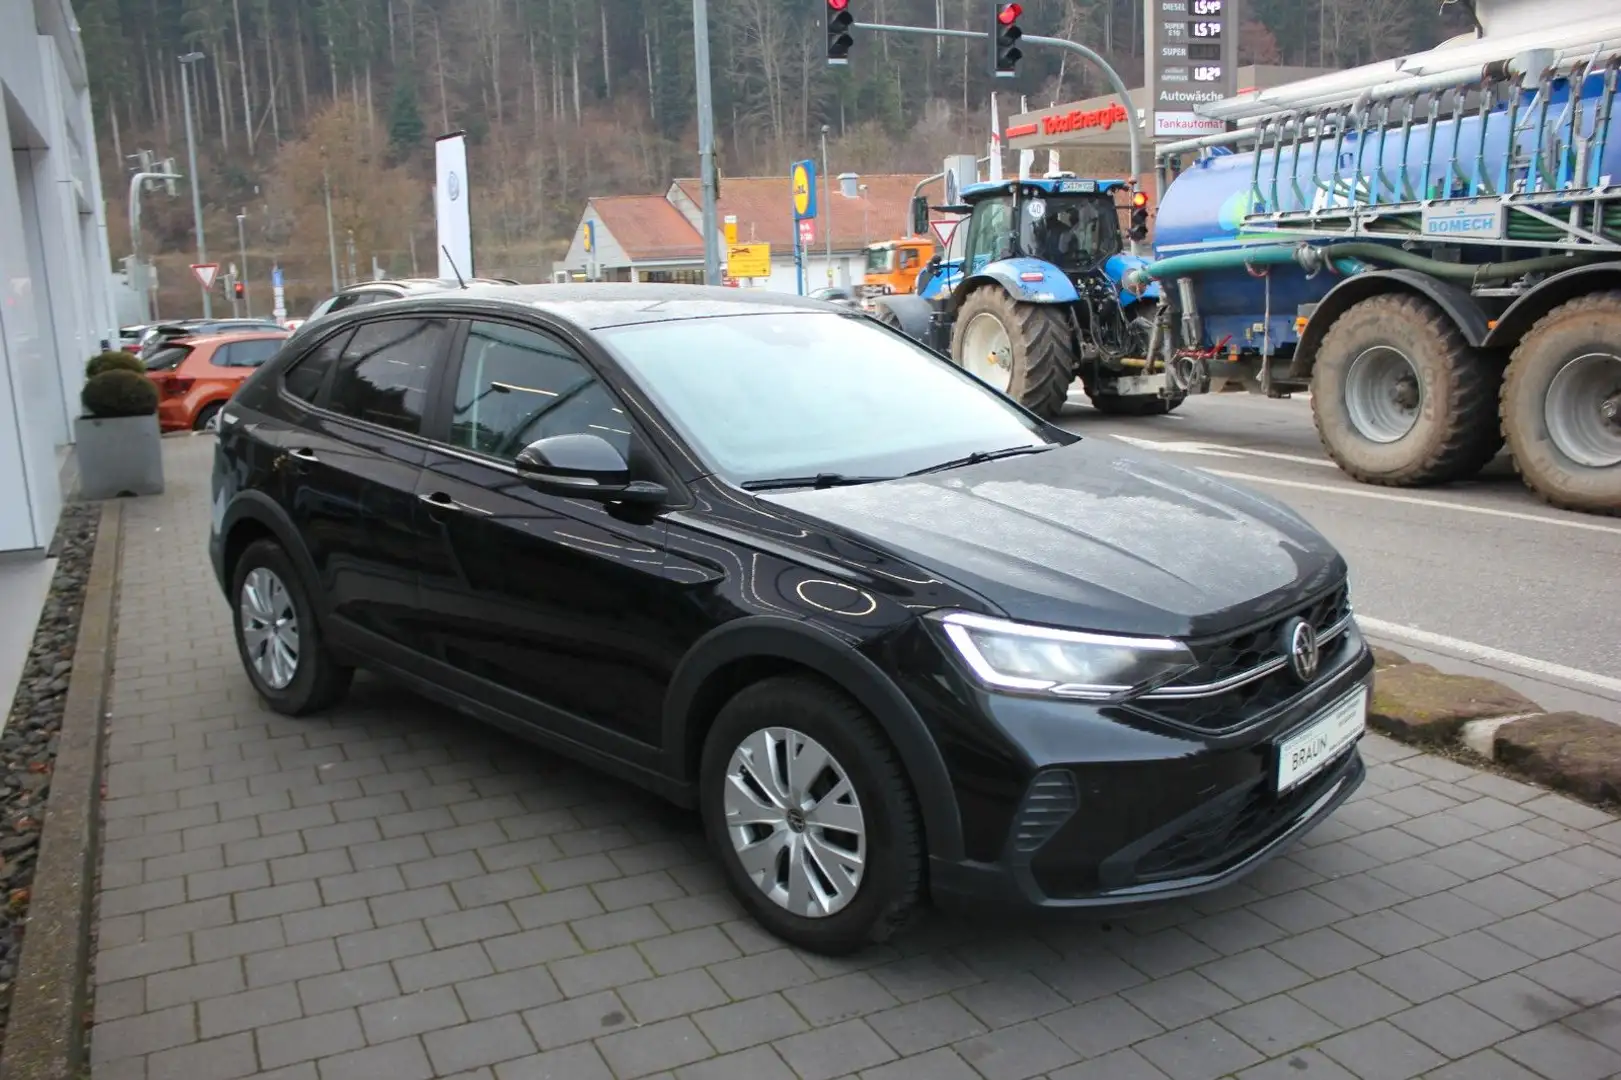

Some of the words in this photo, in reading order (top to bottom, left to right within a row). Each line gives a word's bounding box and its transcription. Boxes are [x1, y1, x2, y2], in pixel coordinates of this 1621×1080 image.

[1162, 3, 1186, 11] DIESEL
[1164, 22, 1185, 30] SUPER
[1162, 47, 1187, 56] SUPER
[1160, 90, 1224, 101] Autowäsche
[1042, 103, 1128, 134] TotalEnergie
[1158, 118, 1224, 129] Tankautomat
[1031, 203, 1041, 214] 40
[1429, 219, 1492, 232] BOMECH
[1291, 733, 1328, 772] BRAUN
